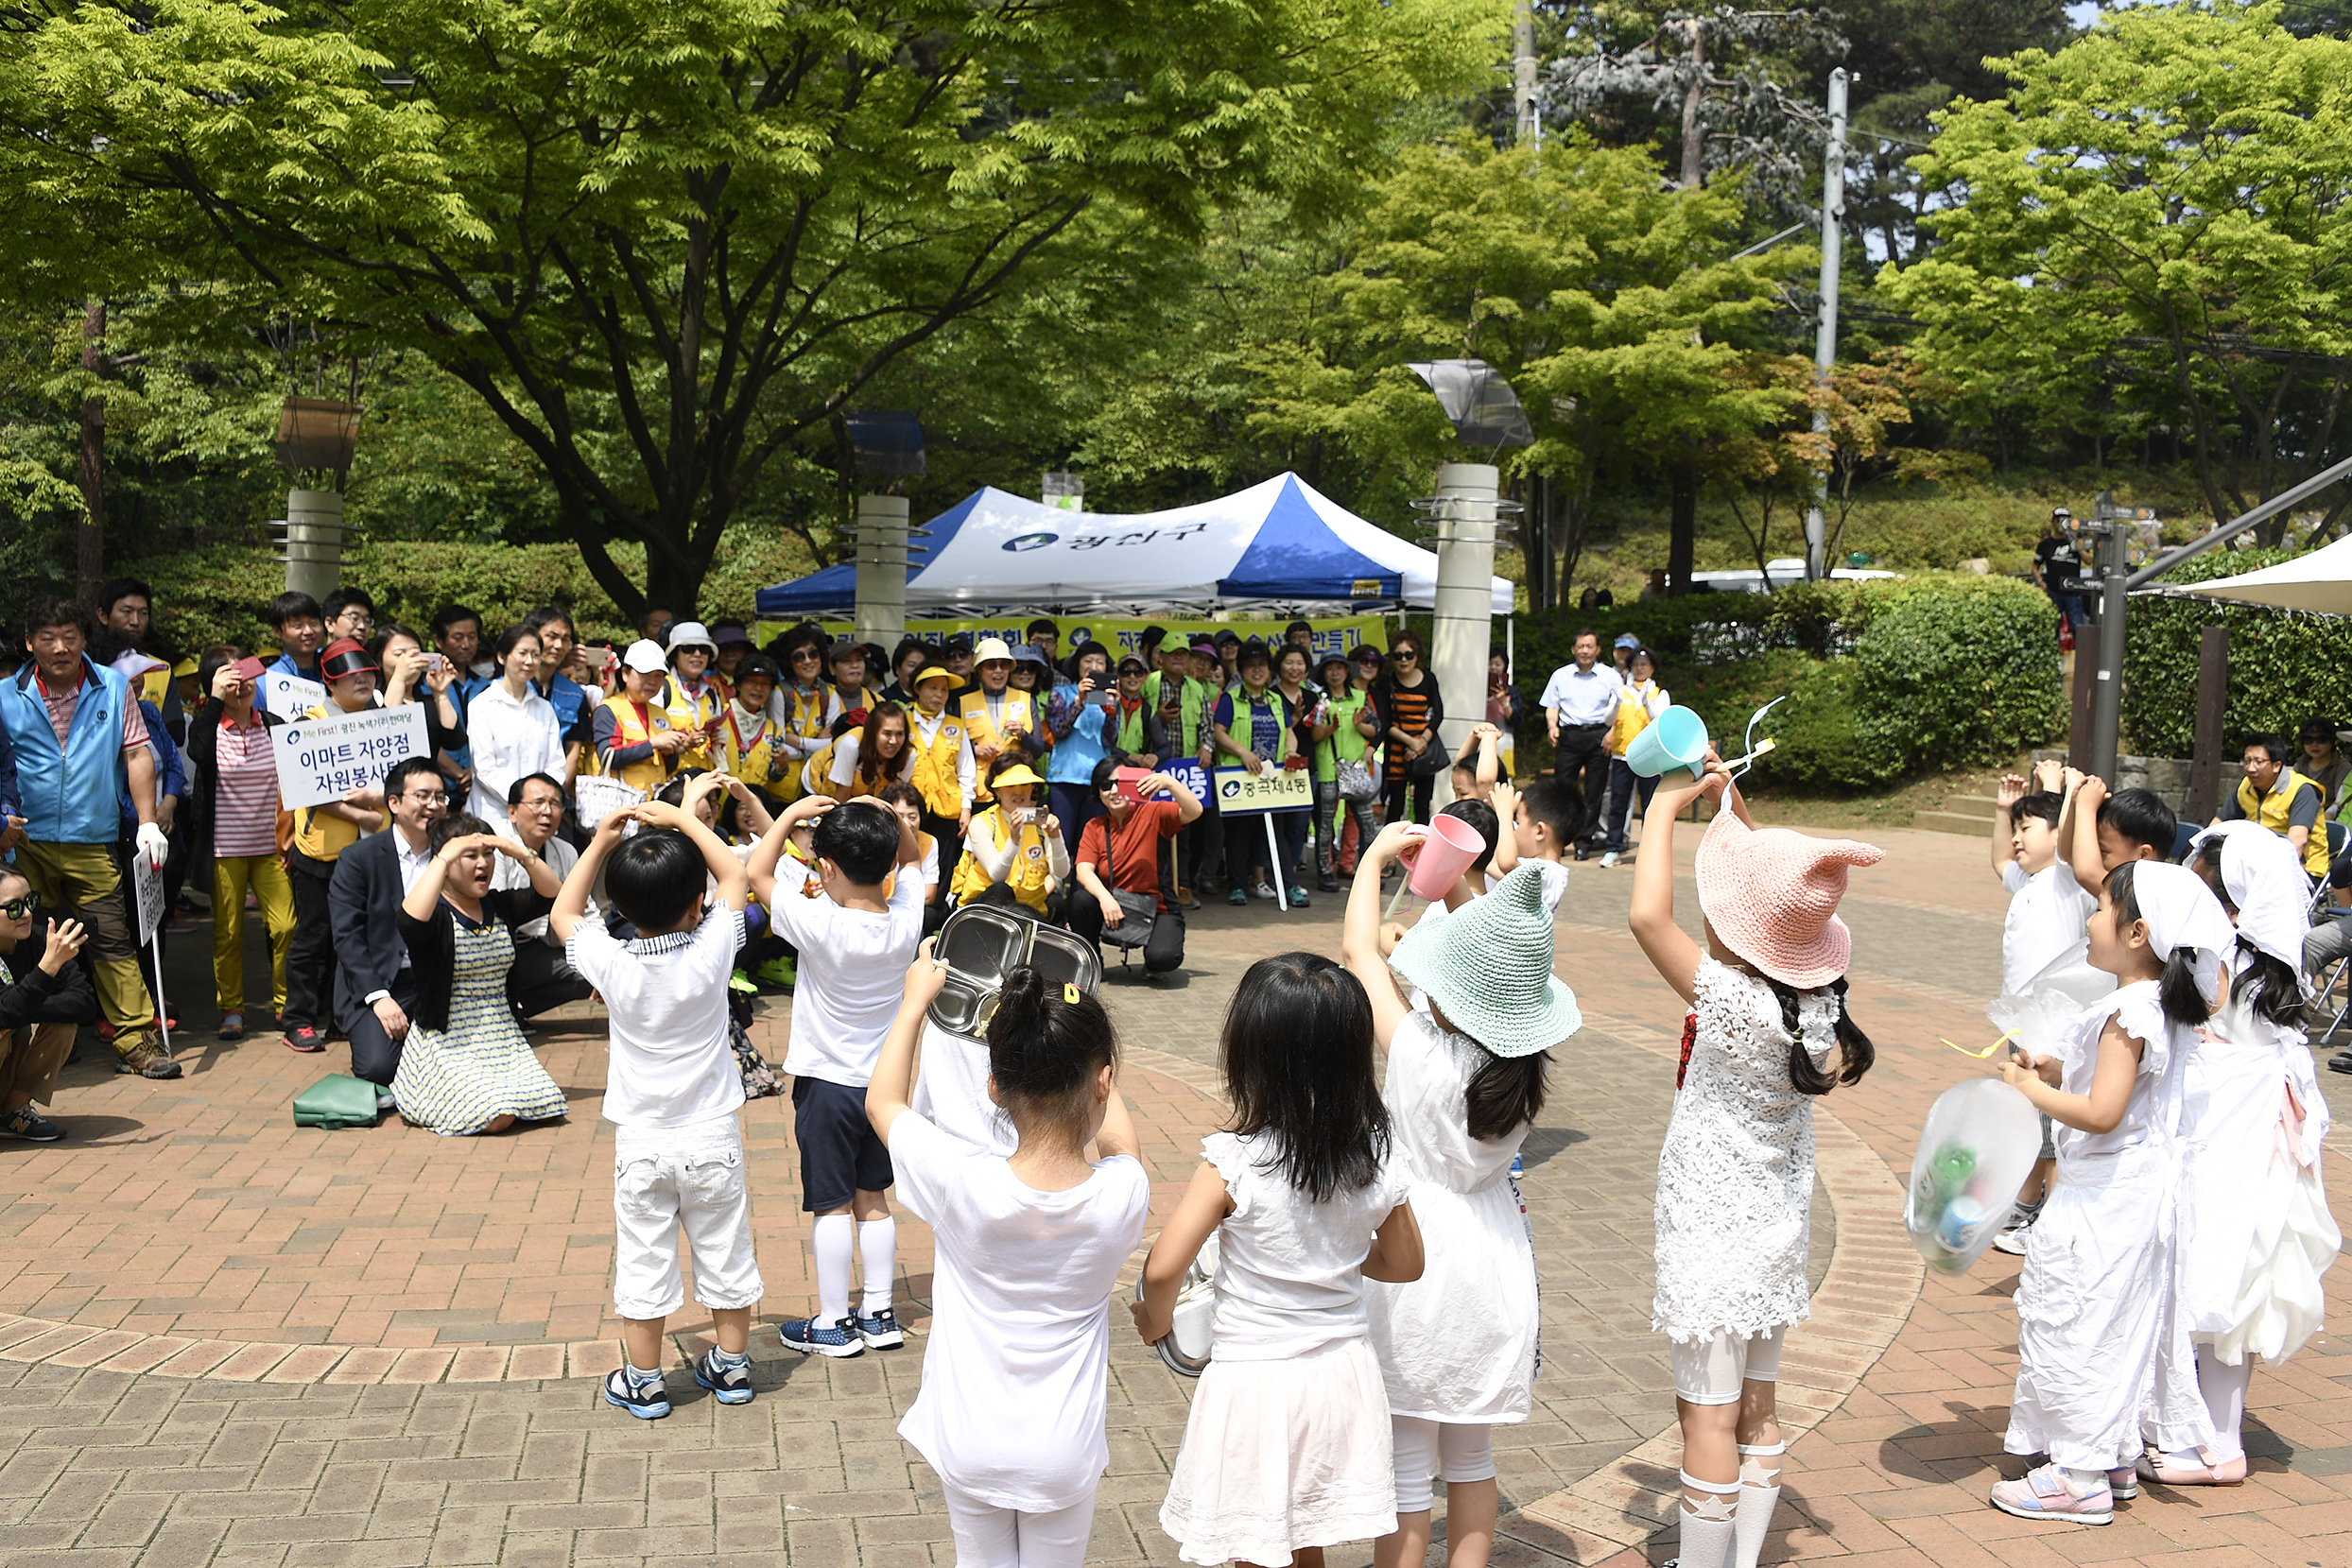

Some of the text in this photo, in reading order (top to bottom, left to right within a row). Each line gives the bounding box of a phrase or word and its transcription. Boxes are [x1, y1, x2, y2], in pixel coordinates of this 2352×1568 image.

[303, 730, 317, 739] Me
[318, 725, 338, 736] First!
[300, 732, 410, 771] 이마트 자양점
[1244, 776, 1306, 798] 중곡제4동
